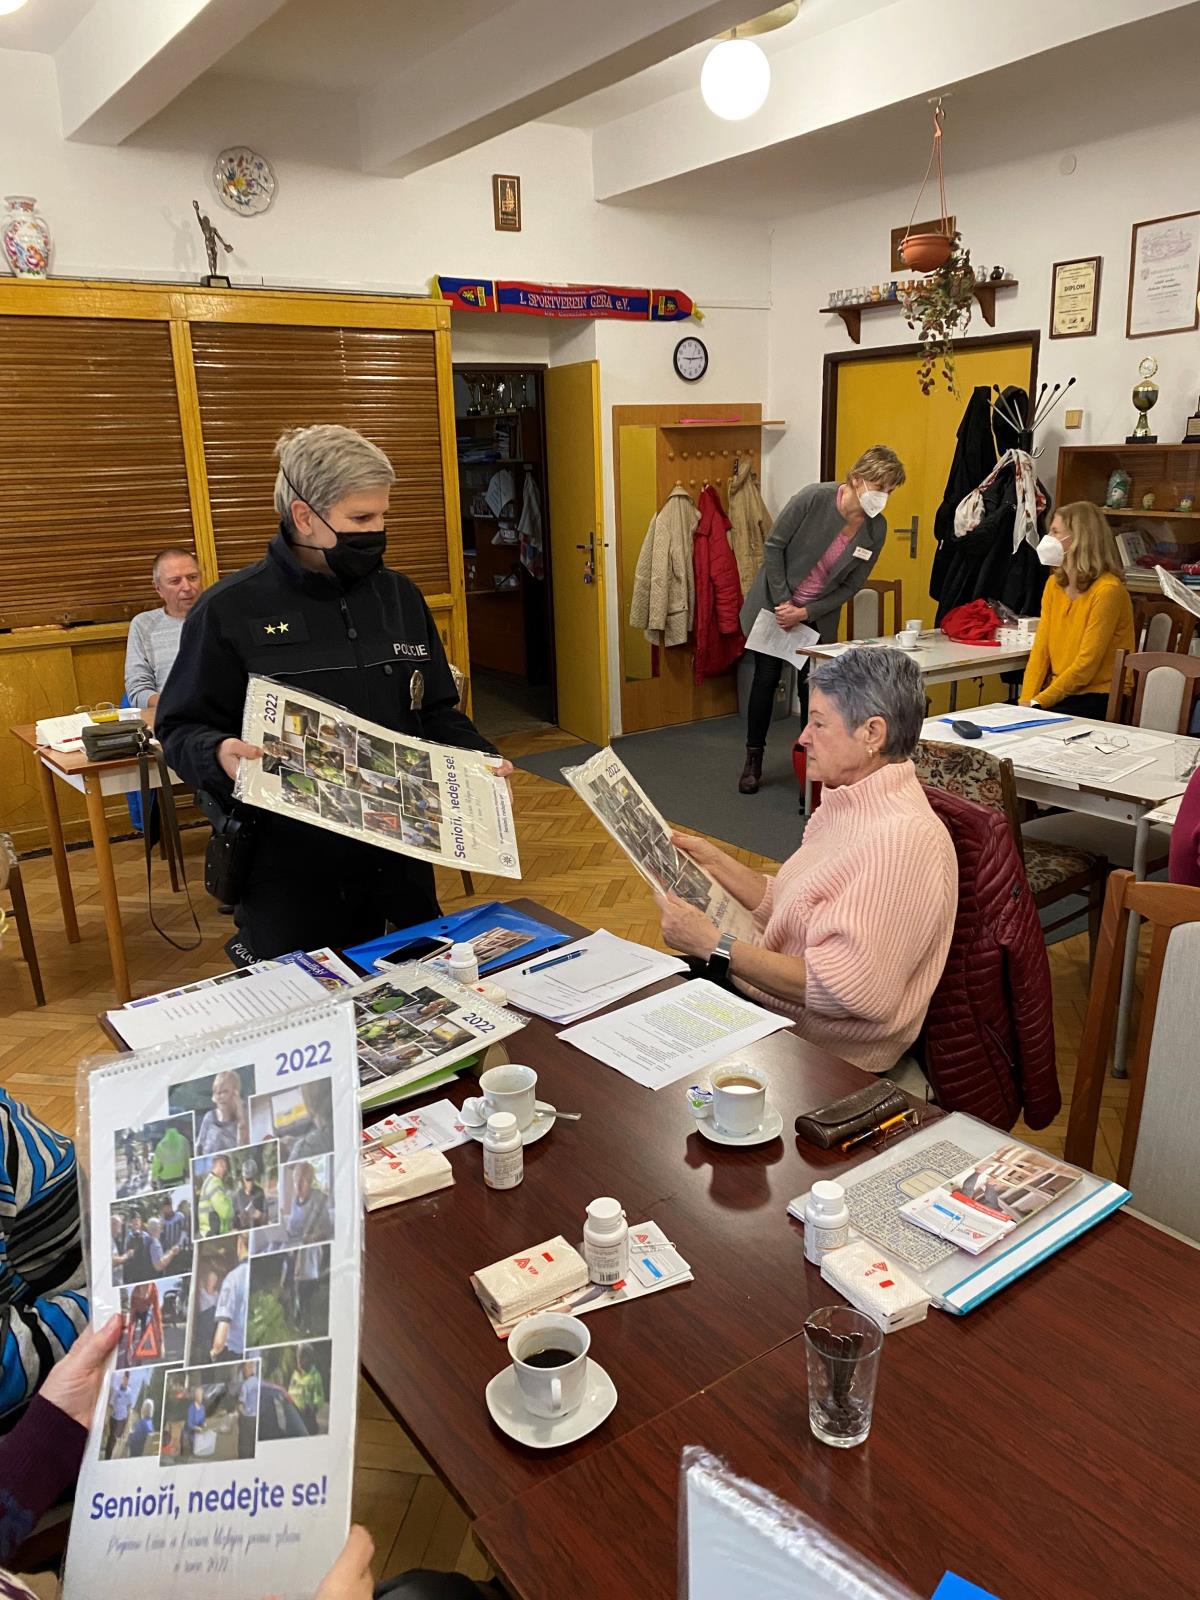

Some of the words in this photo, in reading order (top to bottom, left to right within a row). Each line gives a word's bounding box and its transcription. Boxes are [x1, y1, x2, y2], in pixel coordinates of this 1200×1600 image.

[527, 293, 588, 310] SPORTVEREIN
[590, 294, 613, 309] GERA
[393, 643, 428, 657] POLICIE
[264, 693, 279, 724] 2022
[443, 755, 455, 770] se!
[605, 762, 621, 778] 2022
[461, 1012, 496, 1034] 2022
[275, 1040, 333, 1076] 2022
[90, 1483, 181, 1520] Senioři,
[188, 1477, 285, 1517] nedejte
[291, 1475, 328, 1507] se!
